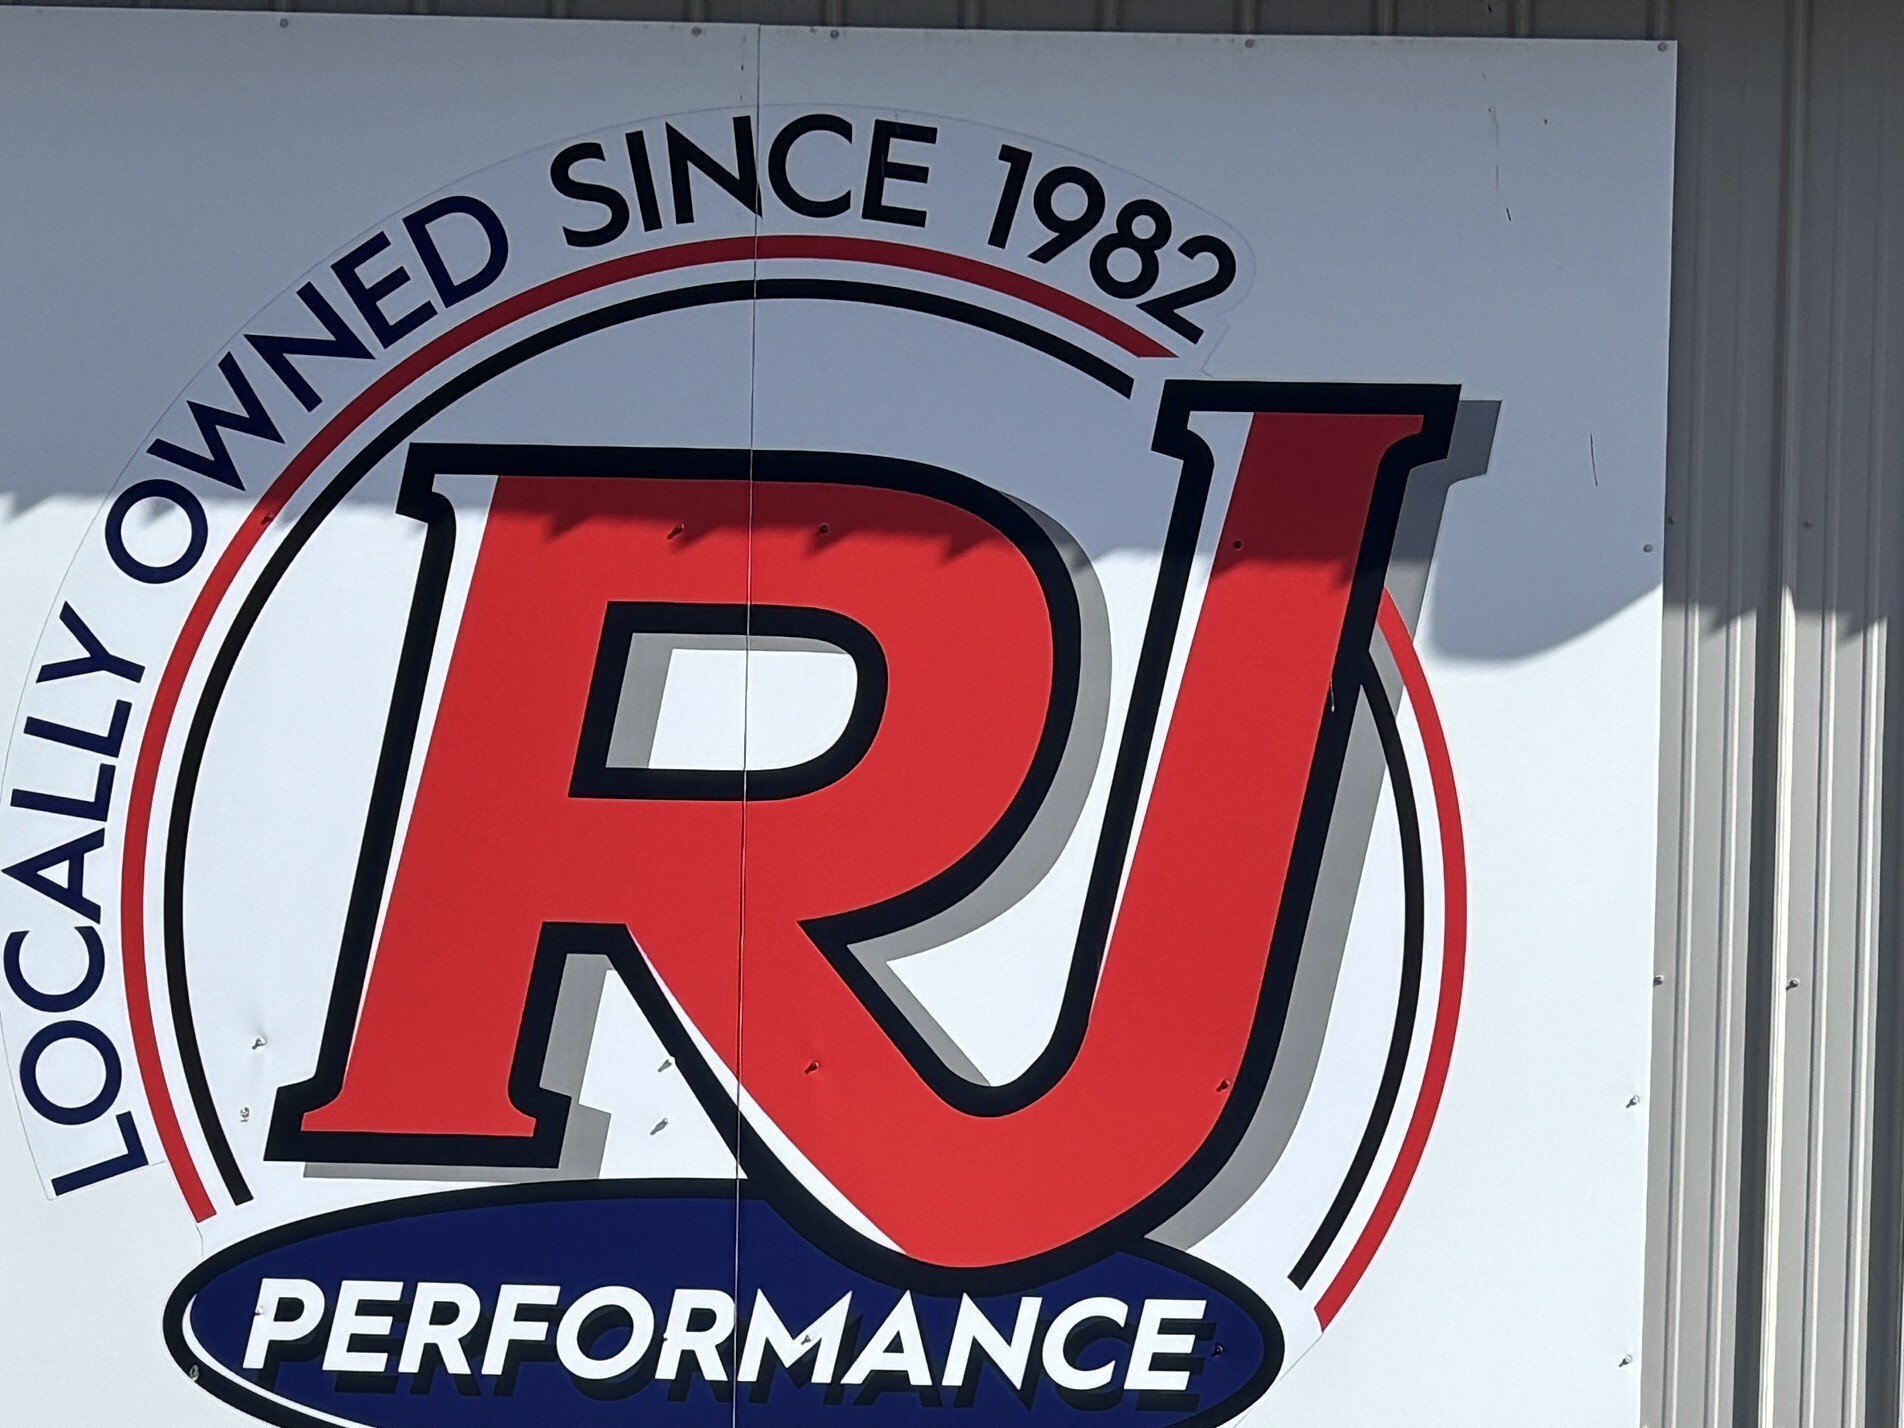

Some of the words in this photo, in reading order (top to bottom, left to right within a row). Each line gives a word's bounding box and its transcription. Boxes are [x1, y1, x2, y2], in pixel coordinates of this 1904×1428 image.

[1, 601, 155, 1197] LOCALLY
[104, 195, 509, 586] OWNED
[549, 113, 939, 248] SINCE
[986, 143, 1238, 346] 1982
[264, 382, 1464, 1296] RJ
[242, 1278, 1208, 1392] PERFORMANCE
